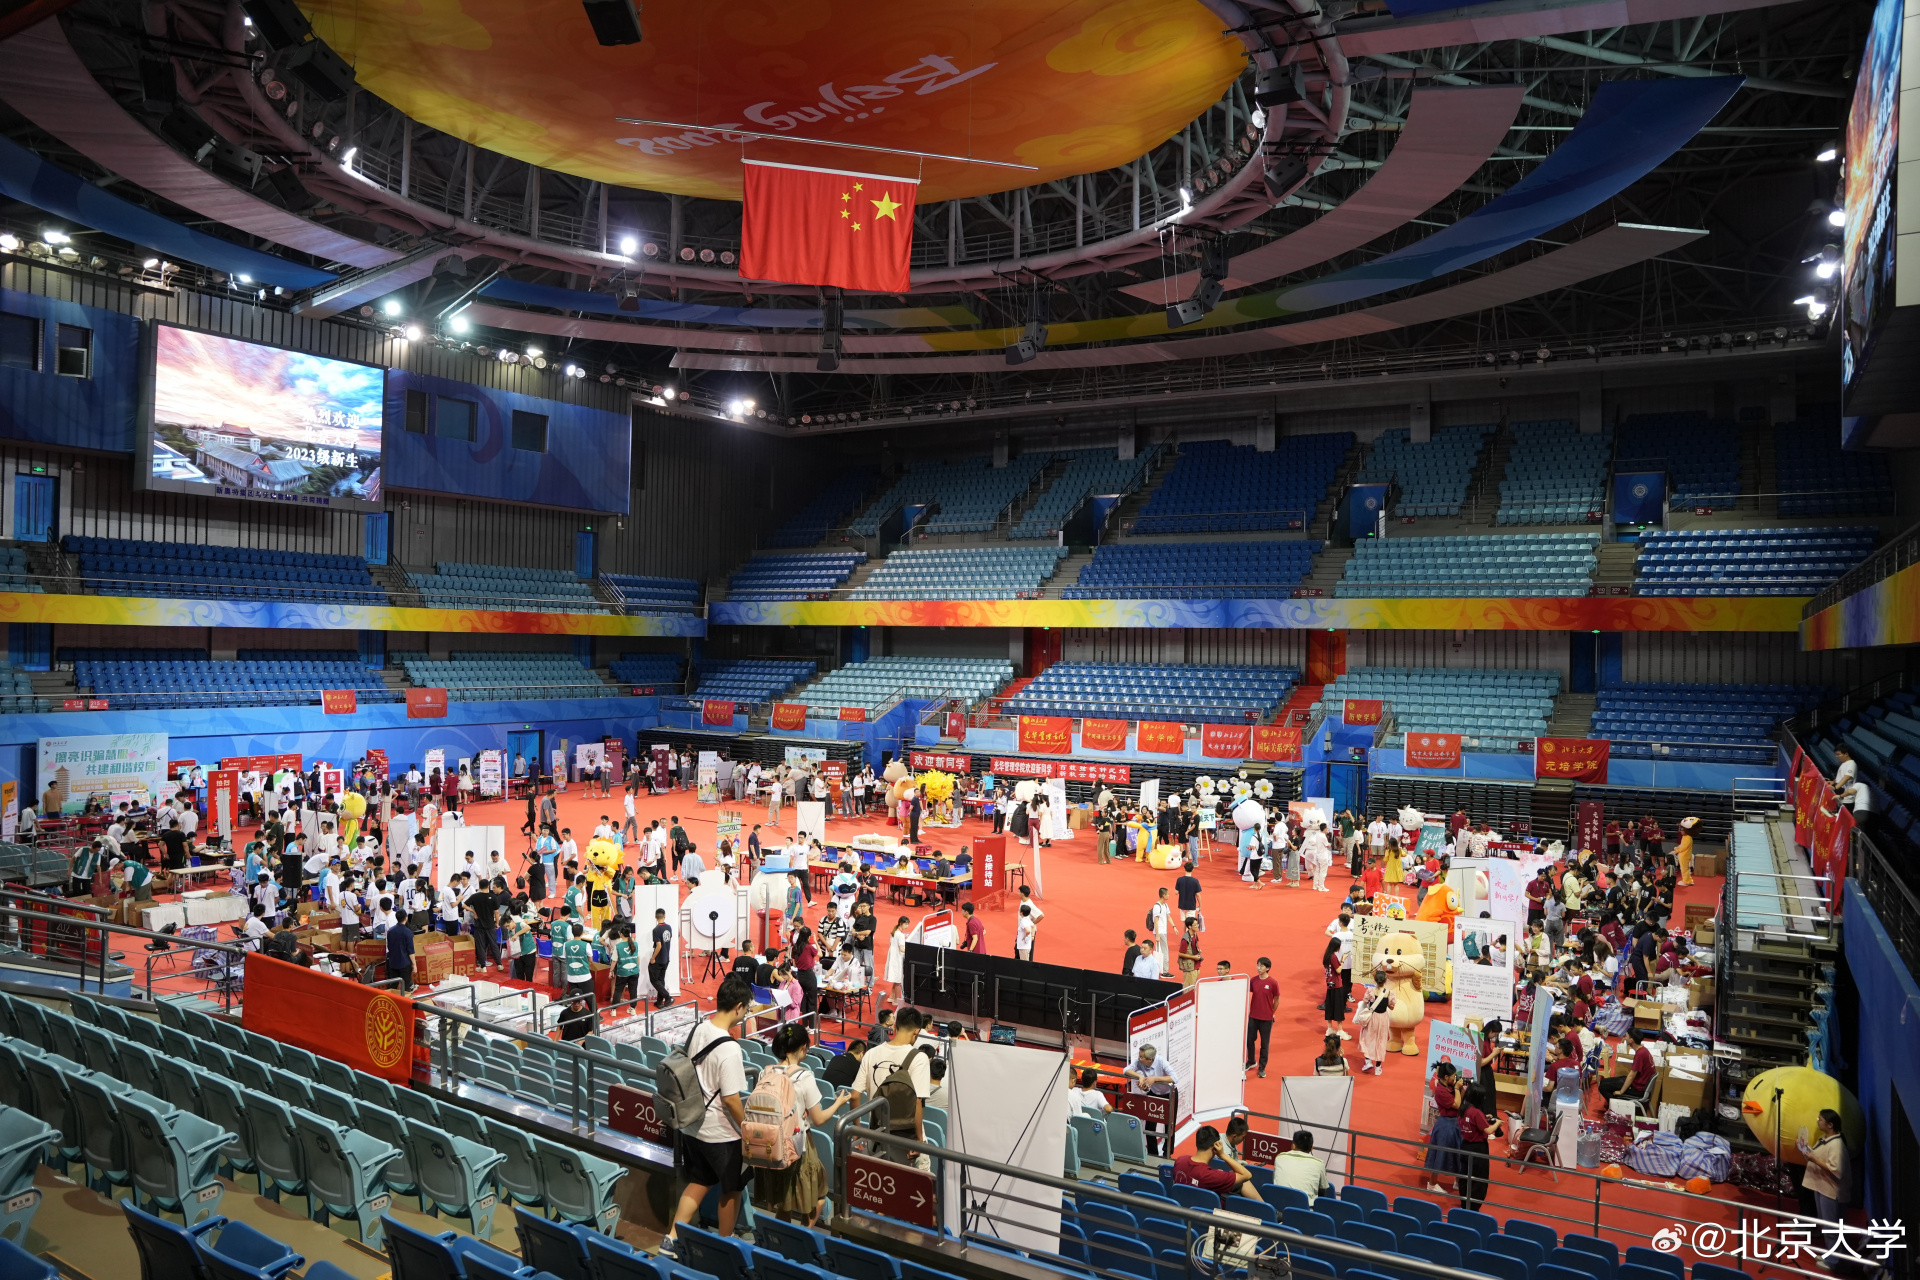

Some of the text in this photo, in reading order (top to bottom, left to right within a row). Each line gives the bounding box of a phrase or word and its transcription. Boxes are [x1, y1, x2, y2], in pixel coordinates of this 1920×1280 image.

[286, 446, 359, 468] 2023级新生
[1146, 733, 1175, 742] 法学院
[1257, 742, 1296, 753] 国际关系学院
[55, 749, 128, 763] 擦亮识骗慧眼
[914, 755, 966, 769] 欢迎新同学
[86, 761, 156, 775] 共建和谐校园
[993, 761, 1052, 775] 光华管理学院欢迎新同学
[1545, 760, 1598, 772] 元培学院
[984, 854, 993, 887] 总接待站
[1143, 1101, 1165, 1113] 104
[644, 1124, 659, 1135] Area
[1252, 1138, 1278, 1153] 105
[854, 1168, 896, 1195] 203
[853, 1187, 883, 1204] 区 Area
